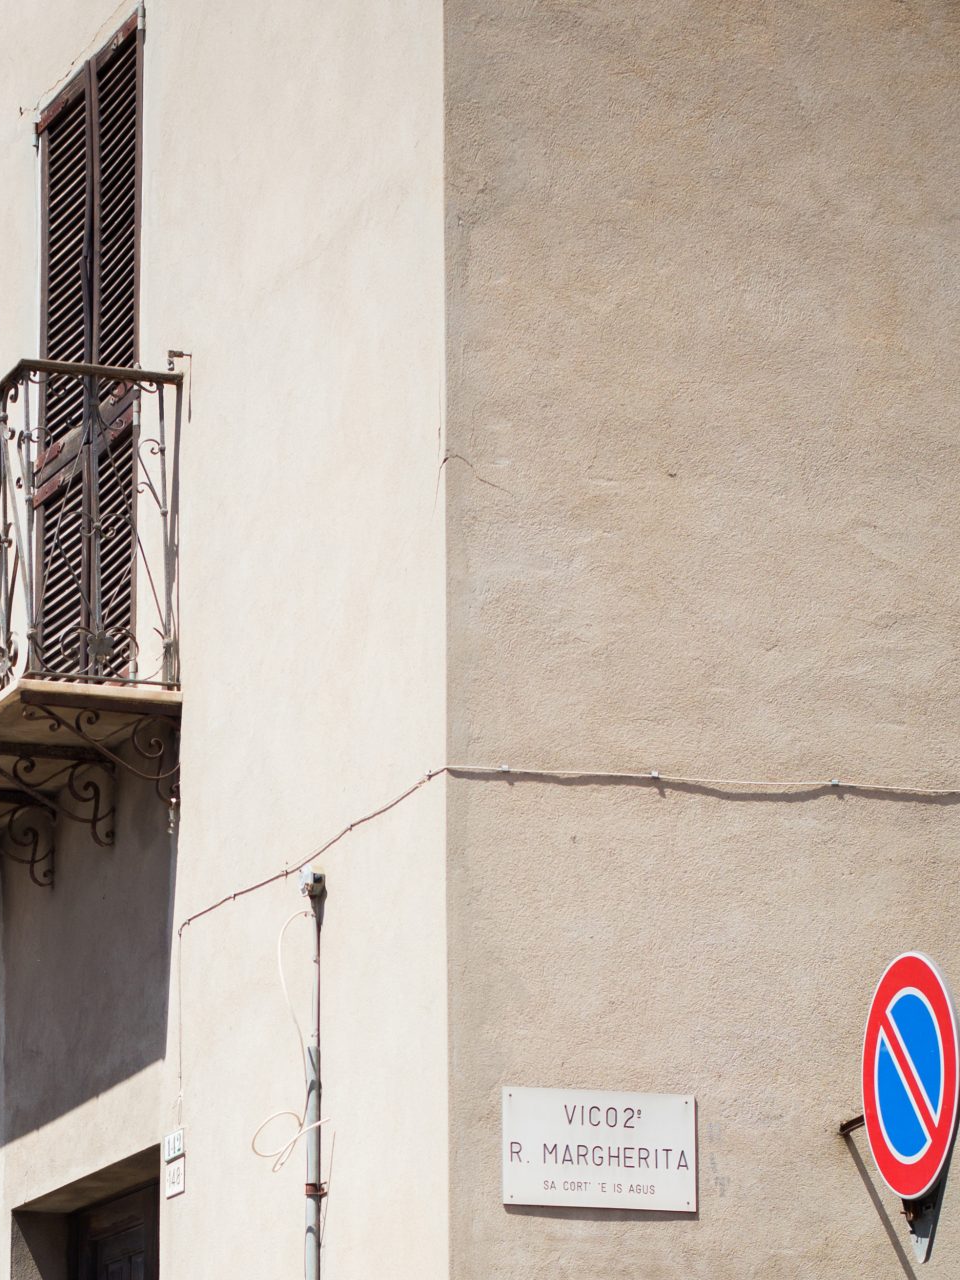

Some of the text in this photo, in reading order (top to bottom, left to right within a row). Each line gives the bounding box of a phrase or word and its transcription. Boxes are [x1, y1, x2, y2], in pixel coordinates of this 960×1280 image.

[510, 1141, 689, 1170] R. MARGHERITA
[543, 1180, 557, 1191] SA
[613, 1183, 623, 1193] IS
[628, 1184, 656, 1195] AGUS
